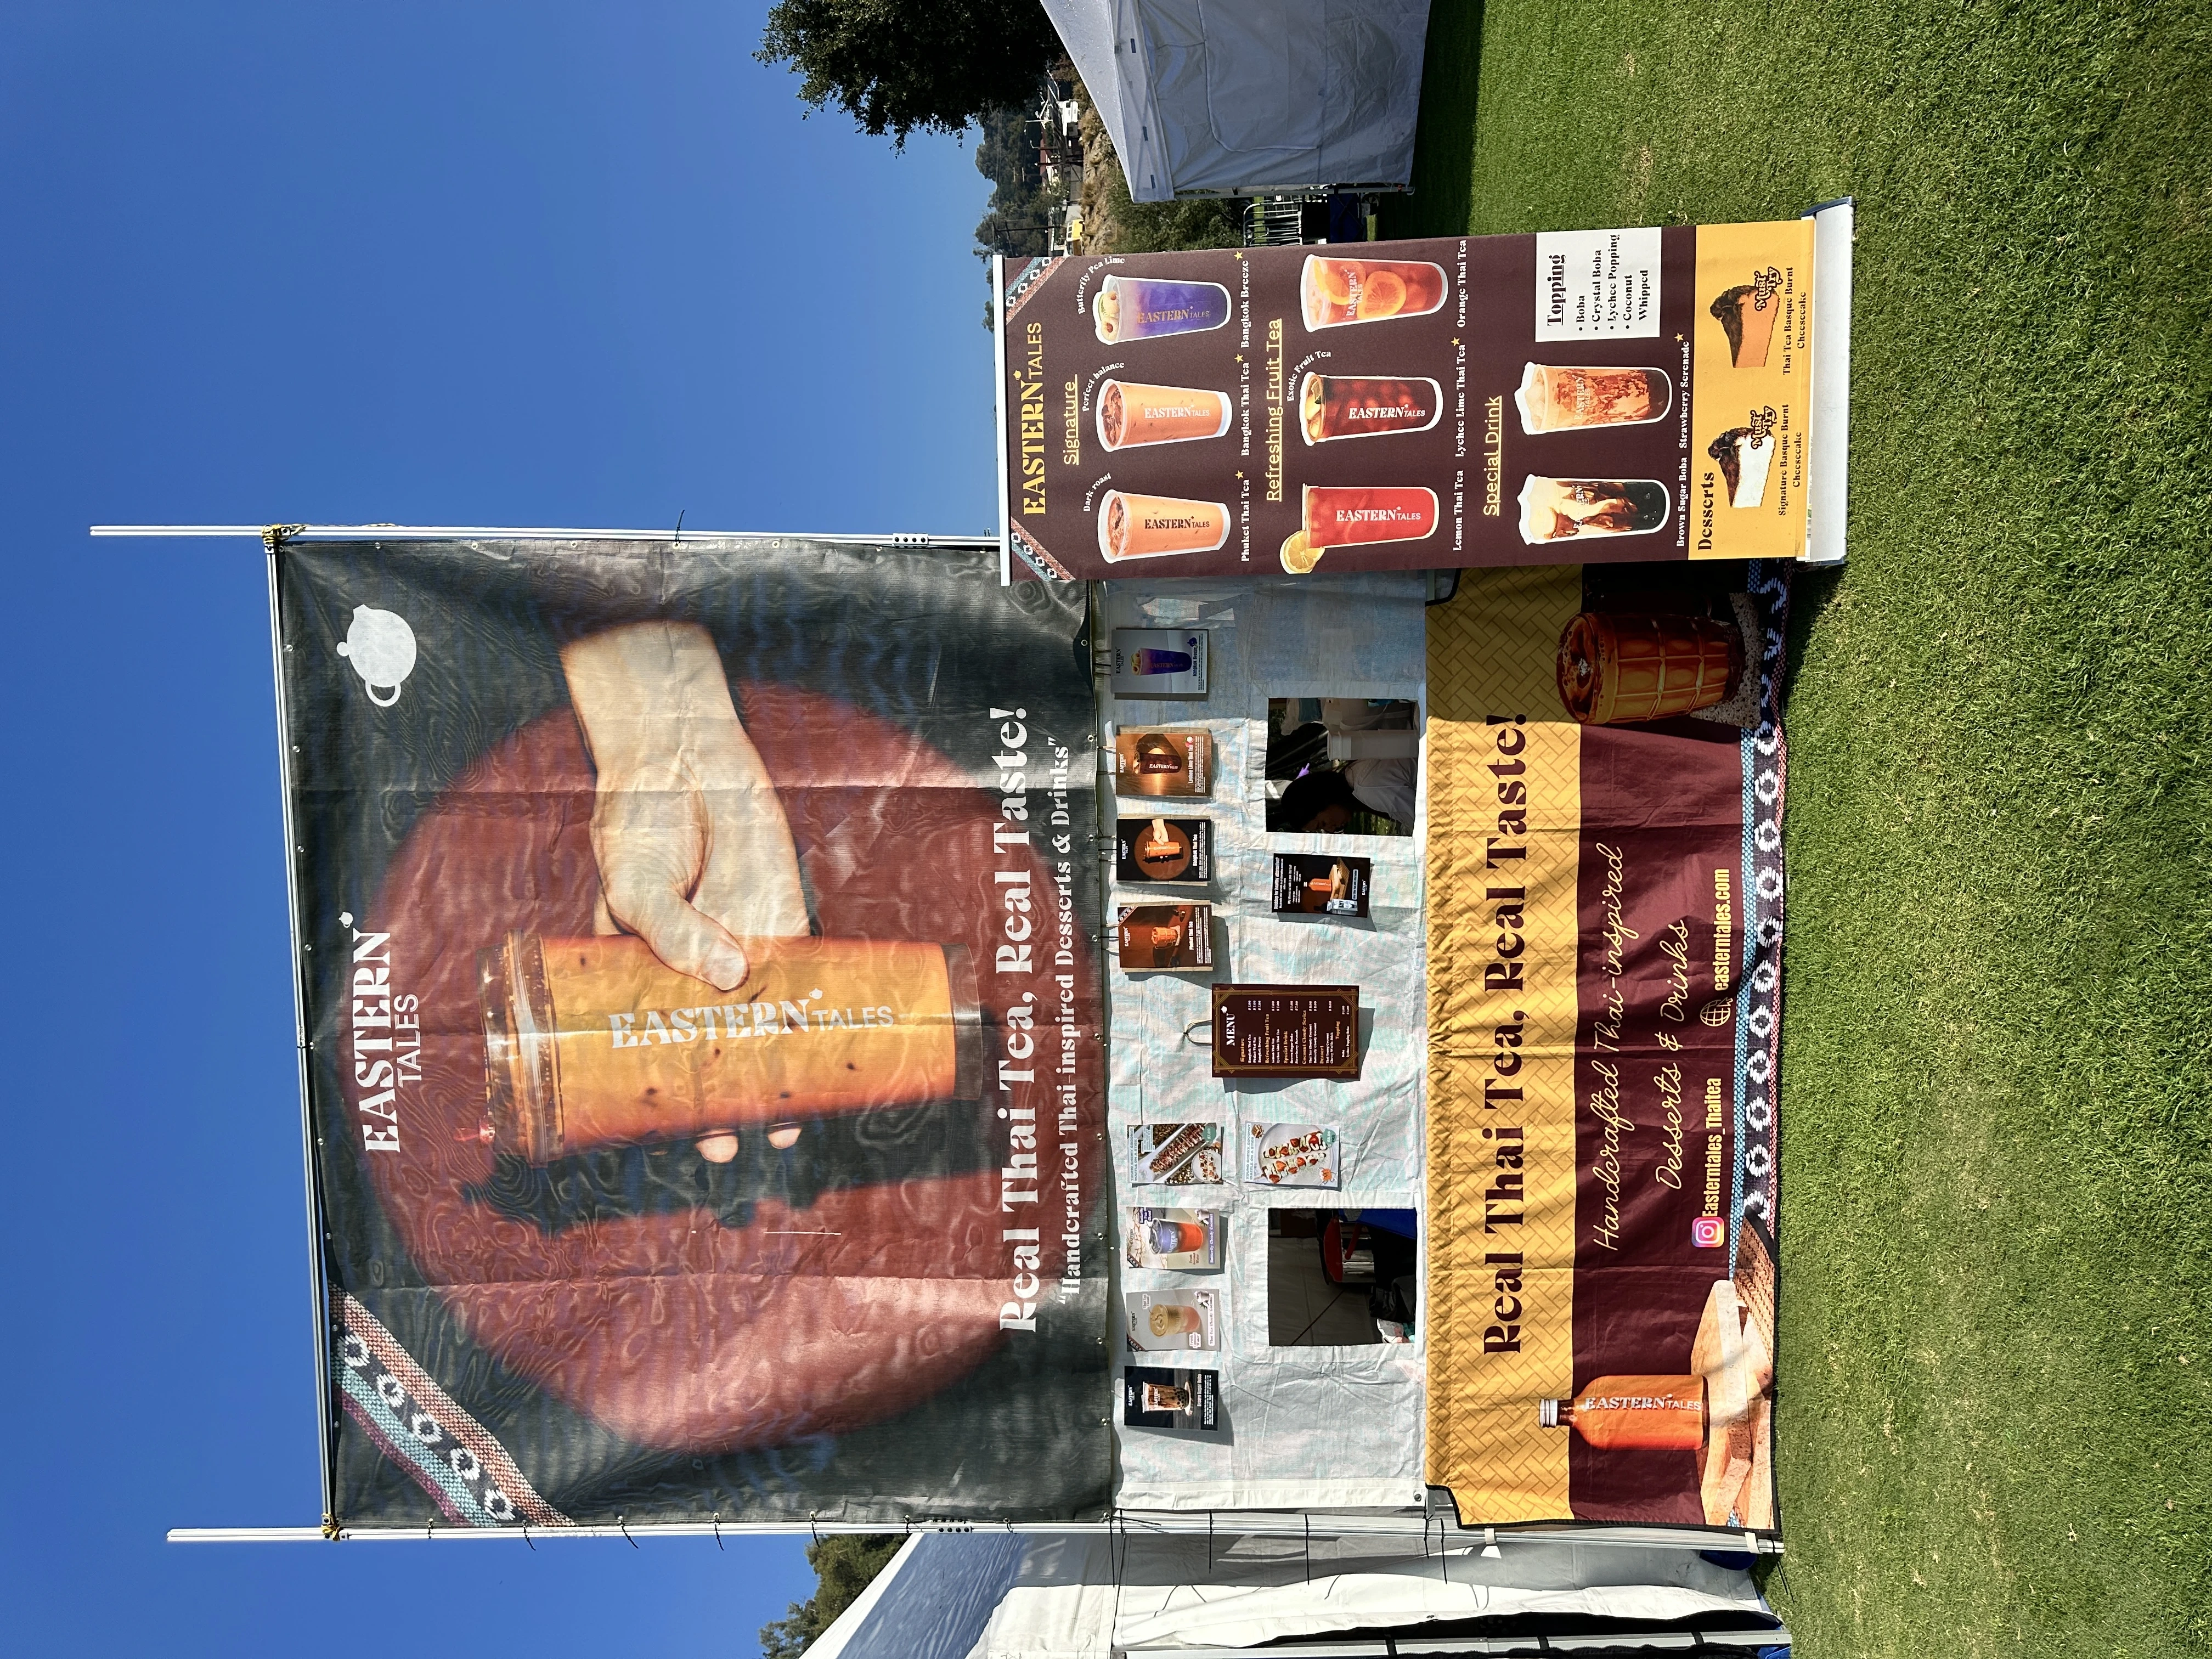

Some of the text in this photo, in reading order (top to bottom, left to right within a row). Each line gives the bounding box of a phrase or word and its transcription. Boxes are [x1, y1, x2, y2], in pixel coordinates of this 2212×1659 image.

[1076, 256, 1125, 314] Butterfly Pea Lime
[1137, 307, 1210, 323] EASTERN TALES
[1241, 261, 1251, 348] Bangkok Breeze
[1347, 271, 1358, 316] EASTERN
[1457, 240, 1469, 328] Orange Thai Tea
[1547, 254, 1566, 326] Topping
[1576, 295, 1585, 323] Boba
[1592, 250, 1602, 322] Crystal Boba
[1607, 234, 1620, 321] Lychee Popping
[1623, 274, 1632, 320] Coconut
[1639, 269, 1650, 320] Whipped
[1754, 271, 1770, 311] Must
[1767, 267, 1782, 290] Try
[1782, 267, 1794, 375] Thai Tea Basque Burnt
[1797, 292, 1806, 349] Cheesecake
[1082, 362, 1125, 411] Perfect-balance
[1144, 407, 1192, 419] EASTERN
[1241, 363, 1251, 456] Bangkok Thai Tea
[1266, 319, 1283, 501] Refreshing Fruit Tea
[1286, 350, 1331, 402] Exotic Fruit Tea
[1348, 407, 1407, 419] EASTERN
[1455, 345, 1466, 457] Lychee Lime Thai Tea
[1573, 377, 1585, 420] EASTERN
[1679, 341, 1690, 449] Strawberry Serenade
[1020, 322, 1046, 515] EASTERN TALES
[1063, 381, 1080, 465] Signature
[1483, 395, 1500, 516] Special Drink
[1751, 410, 1766, 449] Must
[1762, 406, 1777, 429] Try
[1083, 472, 1111, 511] Dark-roast
[1778, 404, 1790, 516] Signature Basque Burnt
[1792, 432, 1802, 488] Cheesecake
[1144, 518, 1192, 529] EASTERN
[1241, 479, 1250, 561] Phuket Thai Tea
[1336, 510, 1421, 522] EASTERN TALES
[1453, 470, 1464, 551] Lemon Thai Tea
[1677, 457, 1689, 546] Brown Sugar Boba
[1698, 472, 1714, 551] Desserts
[1052, 834, 1071, 854] &
[1052, 861, 1074, 966] Desserts
[1712, 868, 1731, 991] easterntales.com
[353, 928, 400, 1153] EASTERN
[394, 994, 421, 1087] TALES
[608, 998, 894, 1048] EASTERN TALES
[990, 707, 1040, 1333] Real Thai Tea, Real Taste!
[1054, 974, 1081, 1136] Thai-inspired
[1226, 1013, 1235, 1046] MENU
[1482, 713, 1530, 1355] Real Thai Tea, Real Taste!
[1589, 842, 1639, 1251] Handcrafted Thai-inspired
[1653, 919, 1689, 1189] Desserts & Drinks
[1702, 1077, 1725, 1217] Easterntales_Thaitea
[1059, 1143, 1081, 1305] “Handcrafted
[1584, 1397, 1703, 1411] EASTERN TALES
